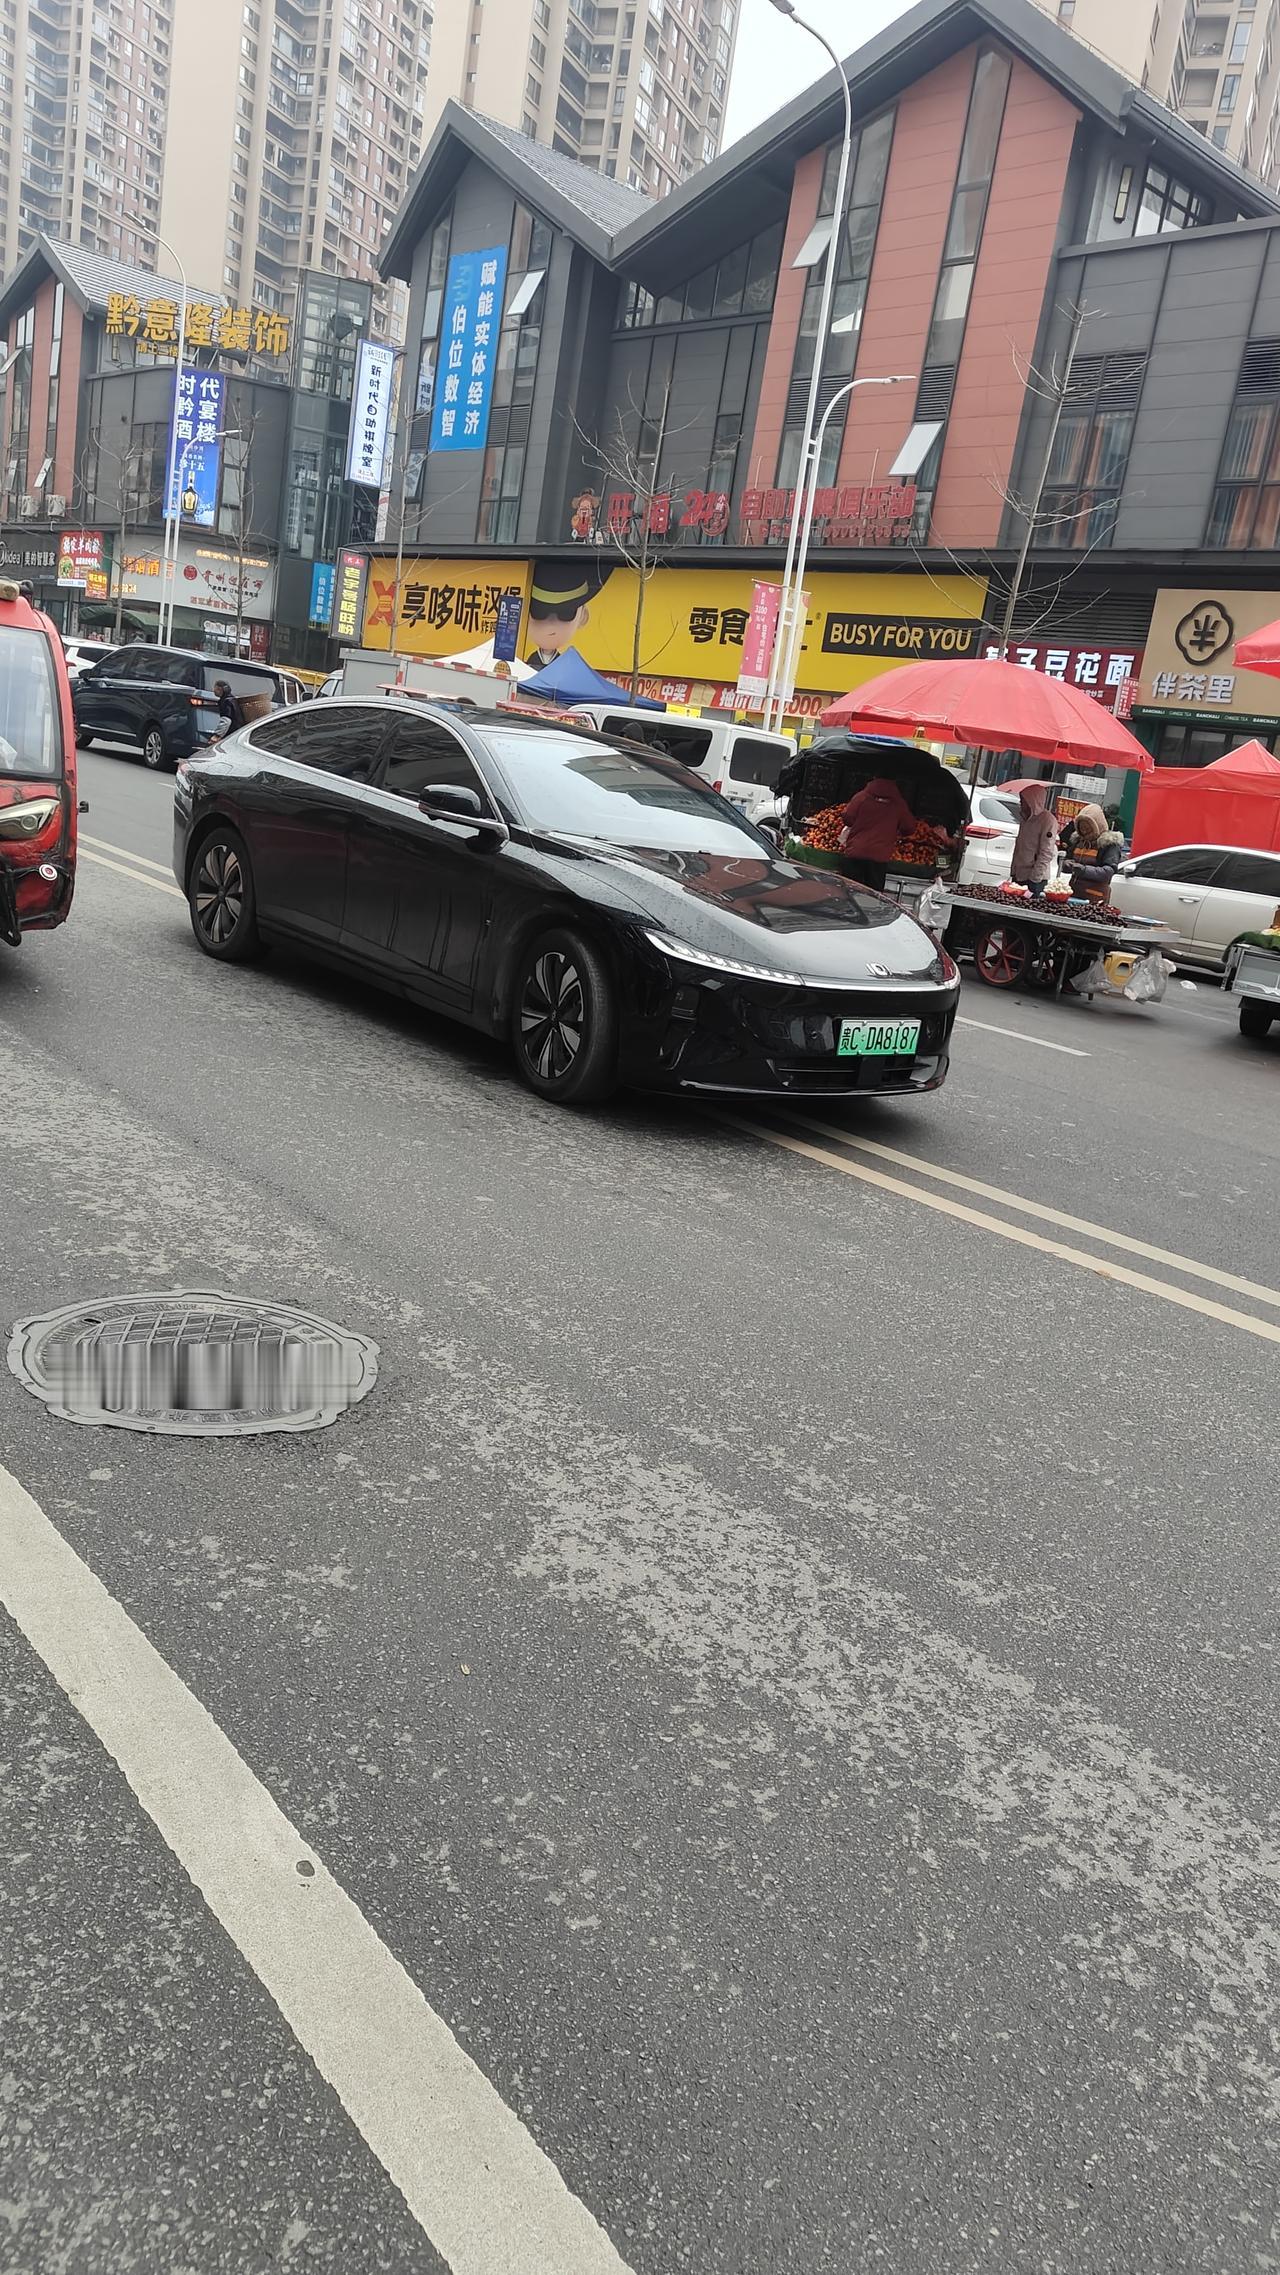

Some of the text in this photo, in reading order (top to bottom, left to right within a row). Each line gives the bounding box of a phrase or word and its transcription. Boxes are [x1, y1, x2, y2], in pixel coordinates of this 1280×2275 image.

[105, 292, 290, 357] 黔意隆装饰
[464, 259, 497, 435] 赋能实体经济
[441, 304, 468, 438] 伯位数智
[361, 364, 382, 469] 新时代自助棋牌室
[830, 622, 972, 652] BUSY FOR YOU
[661, 682, 687, 703] 中奖
[1152, 671, 1236, 704] 伴茶里
